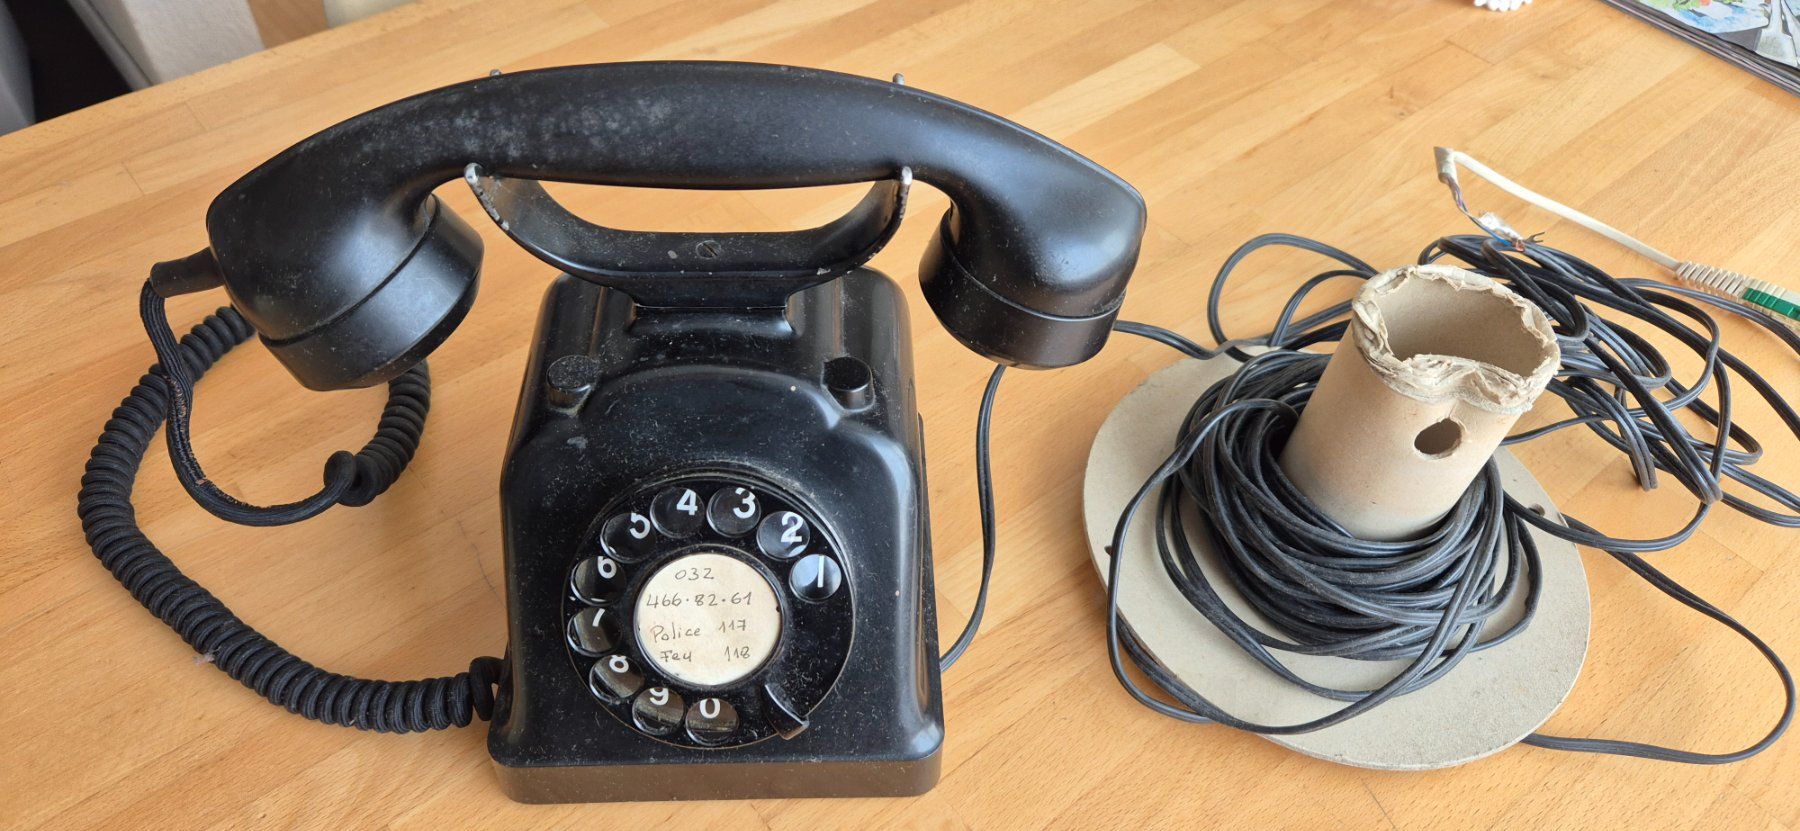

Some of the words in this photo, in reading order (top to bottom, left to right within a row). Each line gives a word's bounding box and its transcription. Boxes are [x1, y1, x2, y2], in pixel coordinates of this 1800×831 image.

[676, 488, 698, 516] 4
[733, 487, 756, 519] 3
[629, 512, 651, 539] 5
[780, 511, 804, 543] 2
[597, 555, 618, 579] 6
[674, 567, 715, 581] 032
[817, 554, 825, 588] 1
[650, 622, 701, 643] Police
[718, 619, 747, 633] 117
[724, 645, 751, 661] 118
[649, 687, 669, 706] 9
